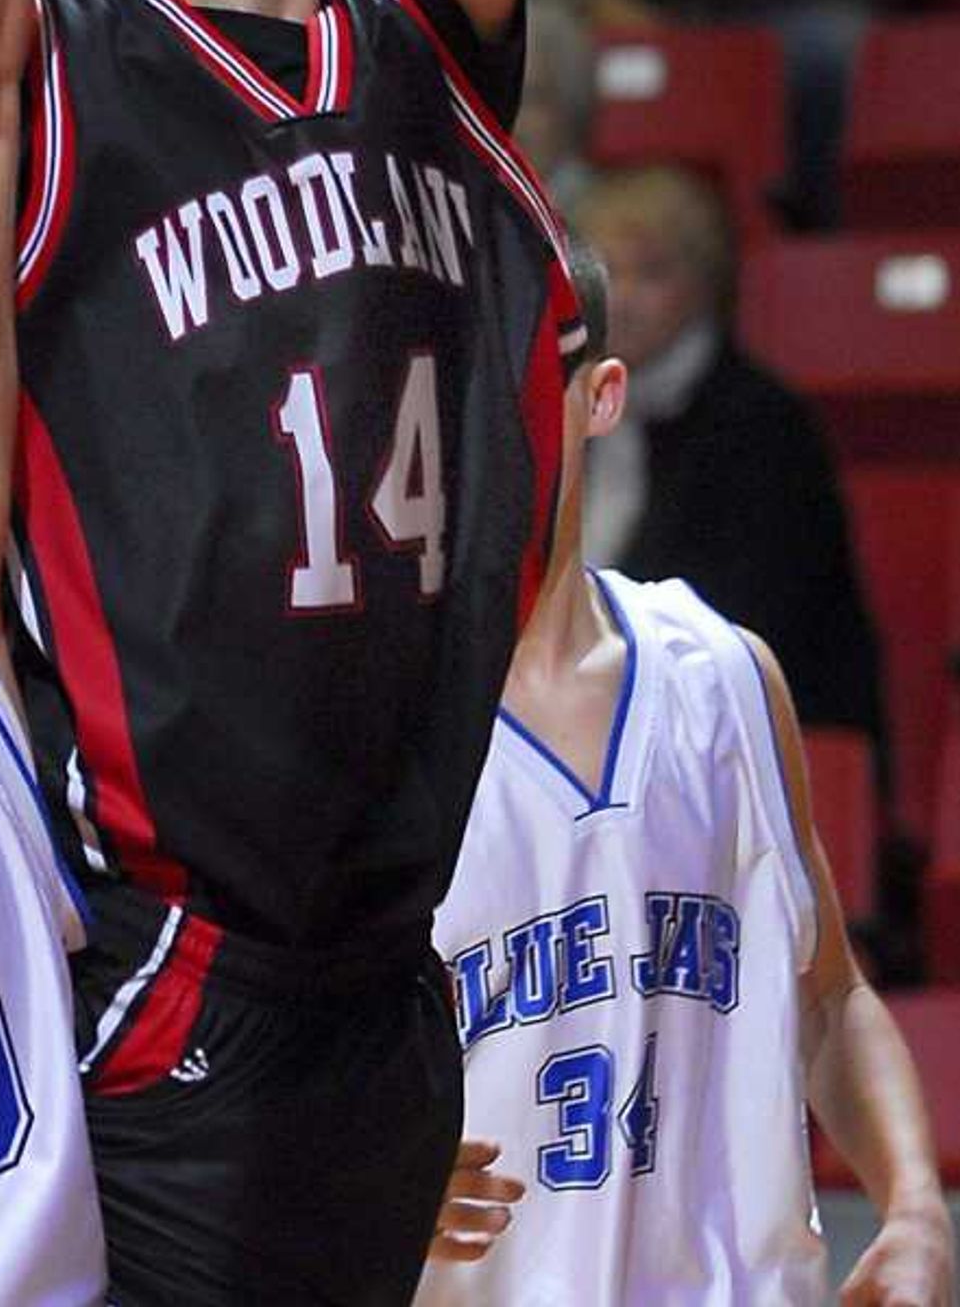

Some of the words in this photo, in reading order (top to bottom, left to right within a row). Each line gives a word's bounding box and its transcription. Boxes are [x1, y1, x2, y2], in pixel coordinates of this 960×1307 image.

[135, 152, 475, 342] WOODLAN
[275, 352, 446, 609] 14
[448, 895, 616, 1052] LUE
